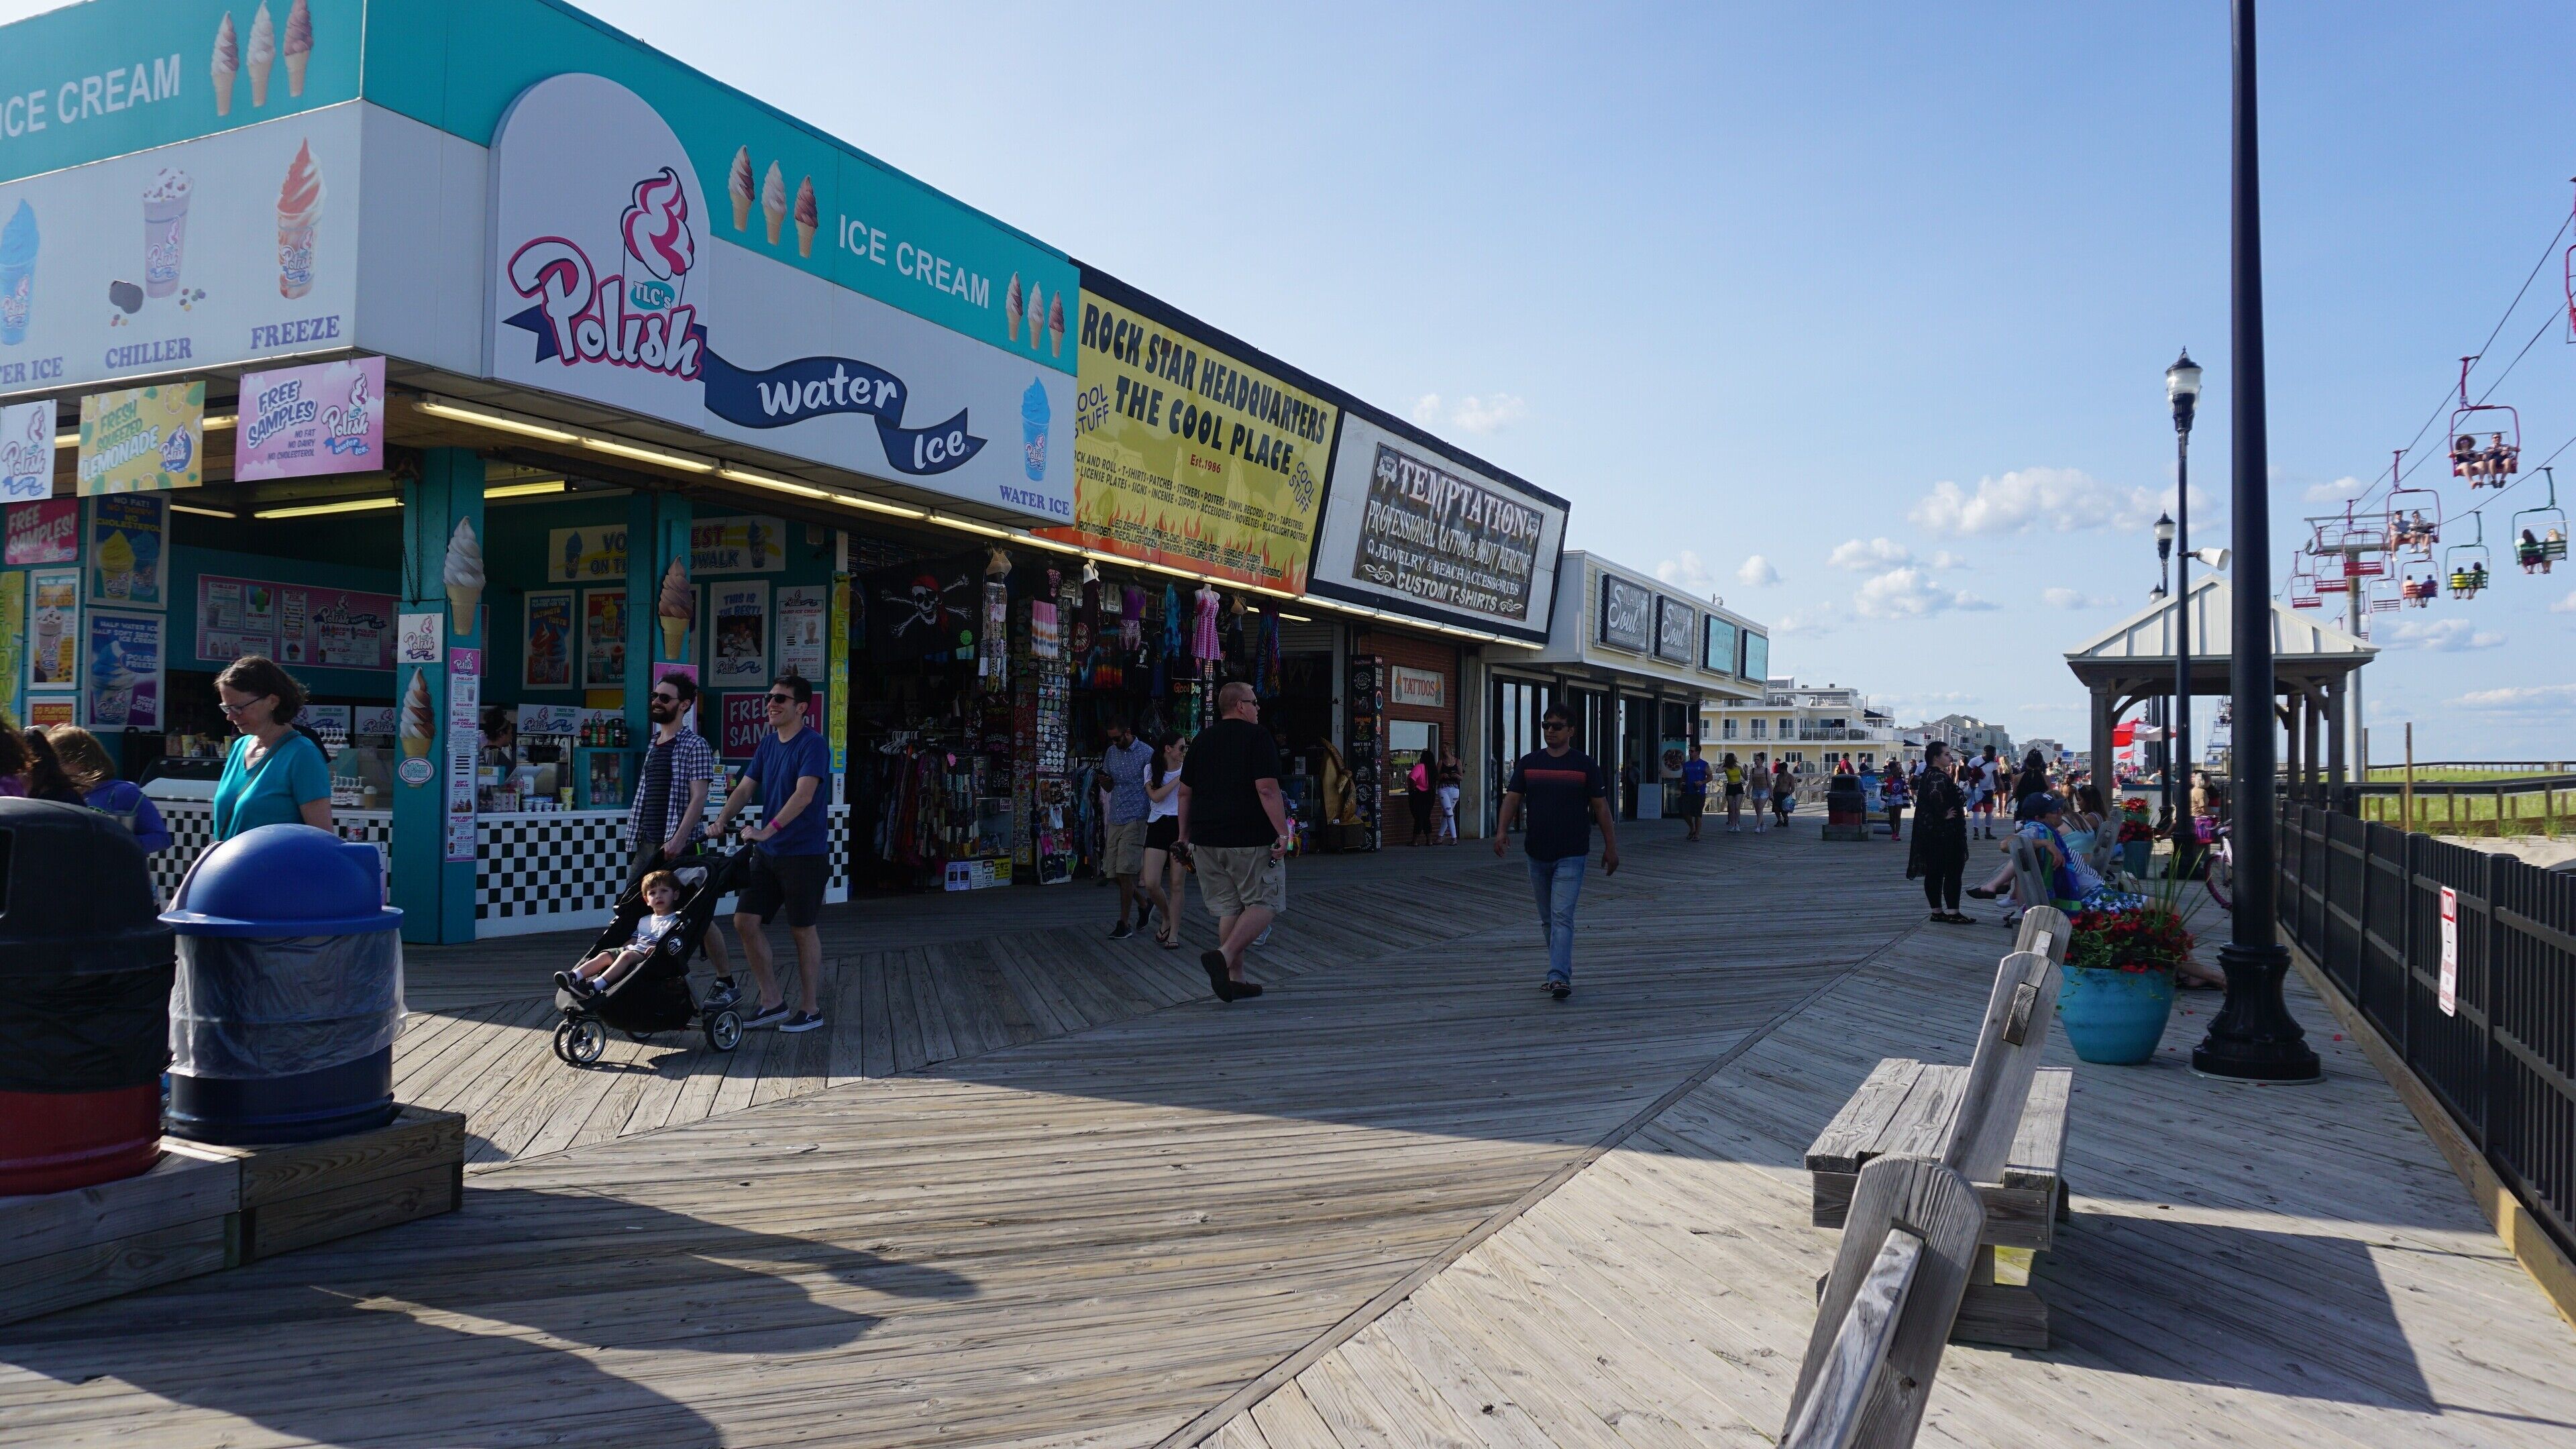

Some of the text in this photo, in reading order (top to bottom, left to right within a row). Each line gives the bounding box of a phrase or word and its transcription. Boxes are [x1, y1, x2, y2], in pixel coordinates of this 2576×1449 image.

[58, 54, 180, 124] CREAM
[839, 214, 990, 309] ICE CREAM
[508, 236, 702, 381] Polish
[633, 280, 672, 310] TLC's
[251, 315, 340, 350] FREEZE
[0, 357, 63, 384] ER ICE
[105, 337, 192, 370] CHILLER
[1081, 303, 1328, 445] ROCK STAR HEADQUARTERS
[258, 379, 301, 416] FREE
[1078, 383, 1108, 413] OOL
[97, 418, 143, 451] SQUEEZED
[101, 400, 137, 433] FRESH
[248, 398, 317, 448] SAMPLES
[321, 406, 368, 438] Polish
[1115, 374, 1294, 475] THE COOL PLACE
[1, 441, 46, 477] Polish
[78, 425, 159, 482] LEMONADE
[277, 449, 315, 458] CHOLESTEROL
[914, 430, 965, 469] Ice
[999, 484, 1069, 516] WATER ICE
[1087, 453, 1101, 468] AND
[1102, 459, 1116, 473] ROLL
[1122, 465, 1146, 482] T-SHIRTS
[1148, 475, 1173, 490] PATCHES
[1177, 483, 1199, 498] STICKERS
[1204, 492, 1224, 506] POSTERS
[1229, 500, 1242, 512] VINYL
[1244, 506, 1264, 517] RECORDS
[1280, 517, 1304, 530] TAPESTRIES
[1289, 475, 1308, 515] STUFF
[1296, 462, 1315, 504] COOL
[1398, 458, 1529, 539] TEMPTATION
[8, 504, 41, 534] FREE
[97, 518, 161, 532] CHOLESTEROL
[1080, 470, 1307, 543] LICENSE PLATES SIGNS INCENSE ZIPPOS ACCESSORIES NOVELTIES BLACKLIGHT POSTERS
[9, 513, 76, 556] SAMPLES!
[1077, 520, 1090, 531] IRON
[1091, 523, 1111, 537] MAIDEN
[1114, 529, 1140, 544] METALLICA
[1143, 537, 1157, 548] OZZY
[1161, 541, 1182, 554] NIRVANA
[1185, 549, 1205, 561] SUBLIME
[1209, 554, 1223, 565] BLACK
[1224, 559, 1244, 570] SABBATH
[1246, 564, 1256, 572] RUSH
[1111, 518, 1123, 530] LED
[1123, 521, 1148, 535] ZEPPELIN
[1152, 528, 1163, 539] PINK
[1164, 531, 1179, 543] FLOYD
[1184, 537, 1208, 551] GRATEFUL
[1224, 547, 1244, 559] BEATLES
[1246, 553, 1261, 564] DOORS
[1365, 500, 1531, 583] PROFESSIONAL TATTOO & BODY PIERCING
[590, 557, 610, 574] ON
[1376, 543, 1519, 596] JEWELRY & BEACH ACCESSORIES
[723, 593, 756, 605] THIS IS
[1396, 572, 1497, 611] CUSTOM T-SHIRTS
[1609, 584, 1641, 633] Soul
[101, 621, 145, 631] HALF WATER
[719, 605, 761, 617] THE BEST!
[1662, 604, 1686, 647] Soul
[403, 632, 434, 651] Polish
[453, 659, 474, 669] Polish
[833, 594, 847, 769] LEMONADE
[1403, 678, 1435, 697] TATTOOS
[524, 718, 548, 732] Polish
[730, 698, 769, 722] FREE
